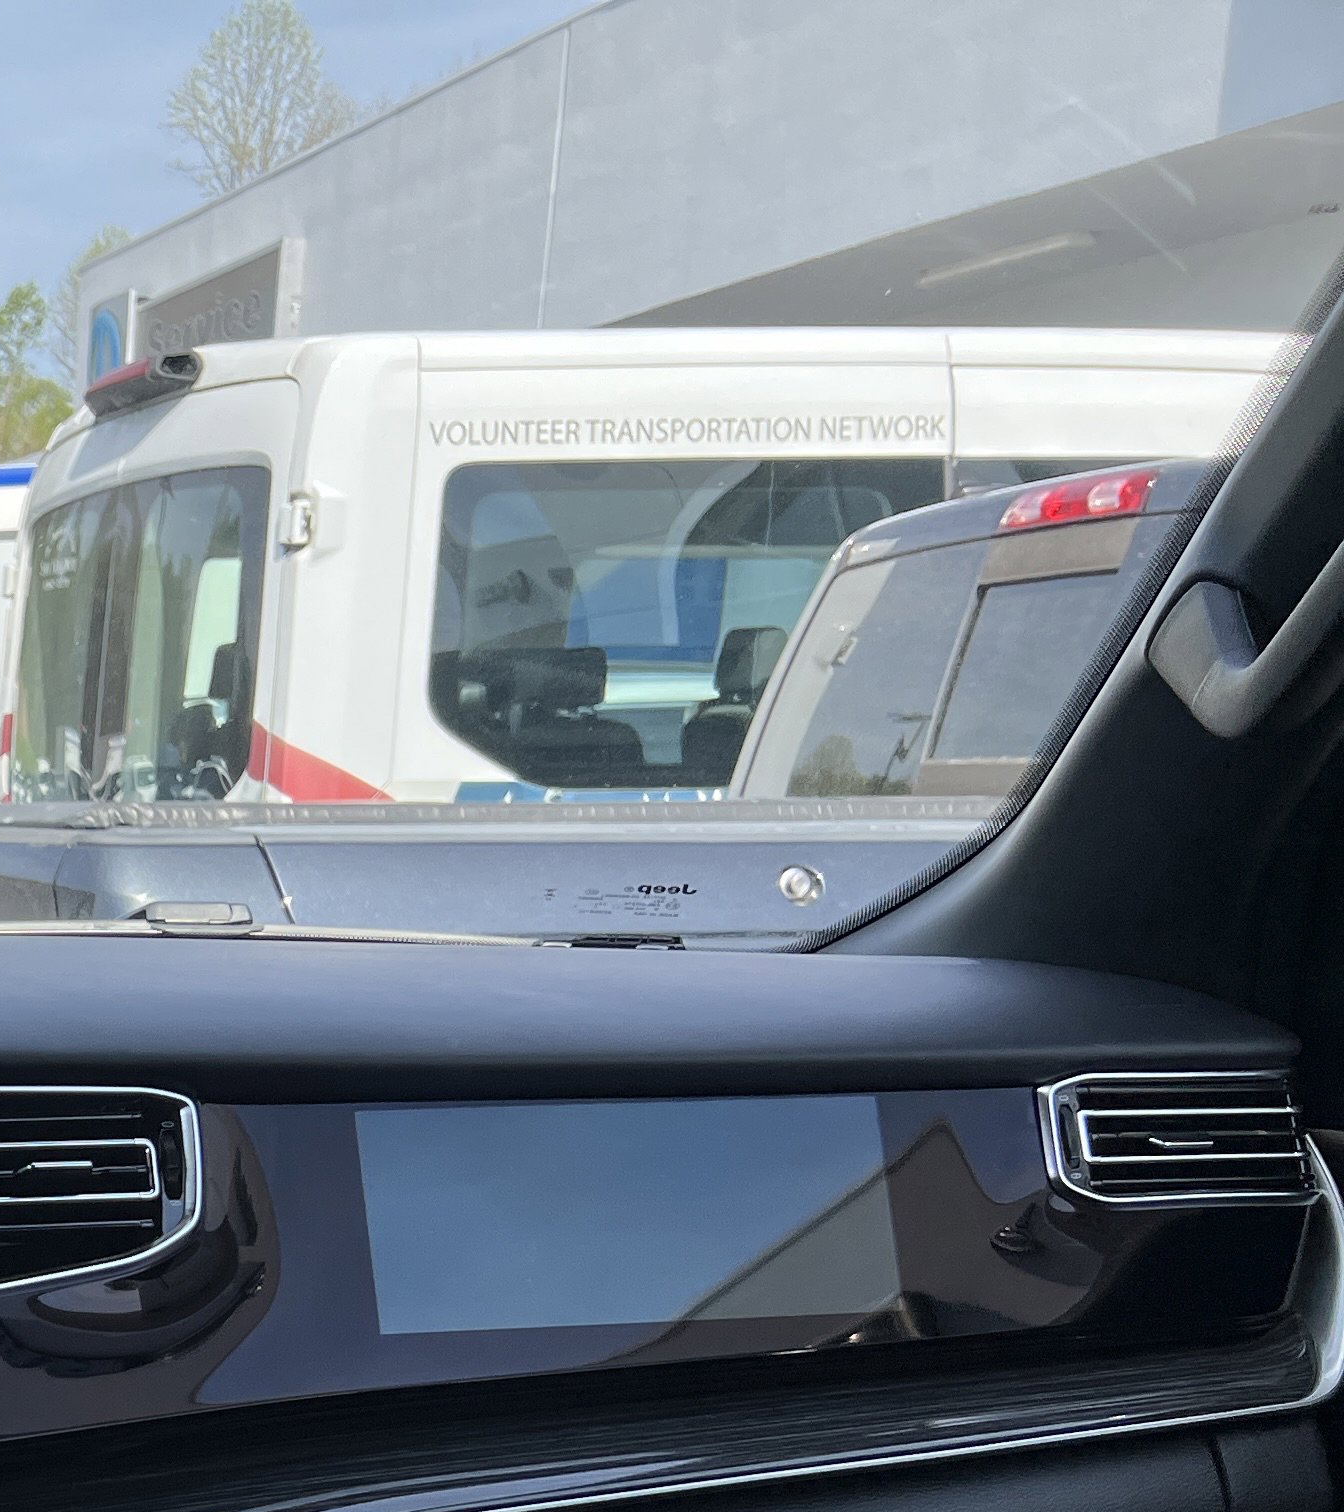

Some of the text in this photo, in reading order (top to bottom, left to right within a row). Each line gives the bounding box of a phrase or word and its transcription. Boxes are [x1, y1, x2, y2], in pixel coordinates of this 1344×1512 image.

[428, 413, 946, 446] VOLUNTEER TRANSPORTATION NETWORK
